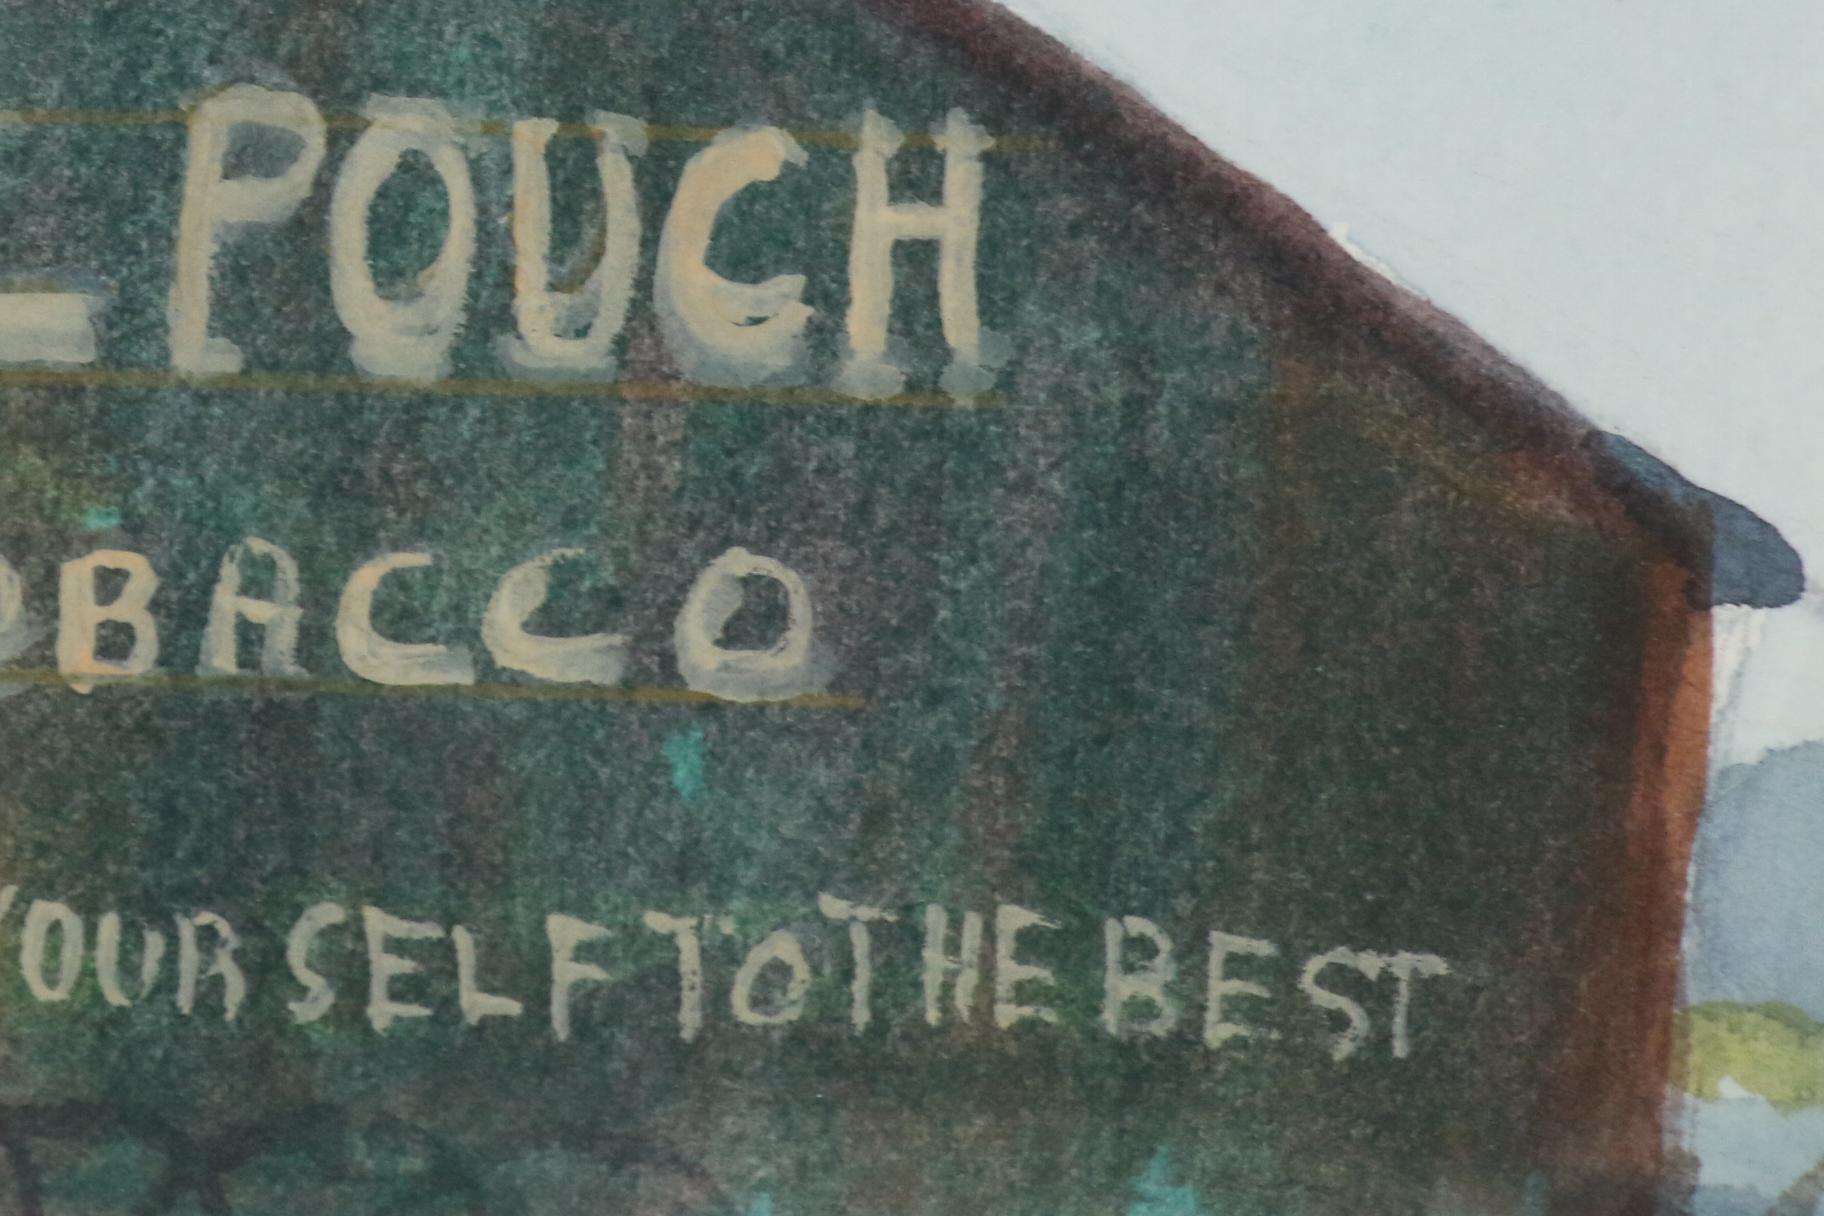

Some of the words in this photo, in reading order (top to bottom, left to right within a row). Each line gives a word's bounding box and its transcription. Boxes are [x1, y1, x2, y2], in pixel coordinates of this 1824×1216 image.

[167, 82, 1008, 402] POUCH
[642, 904, 810, 1042] TO
[817, 892, 1063, 1036] THE
[1102, 912, 1449, 1062] BEST
